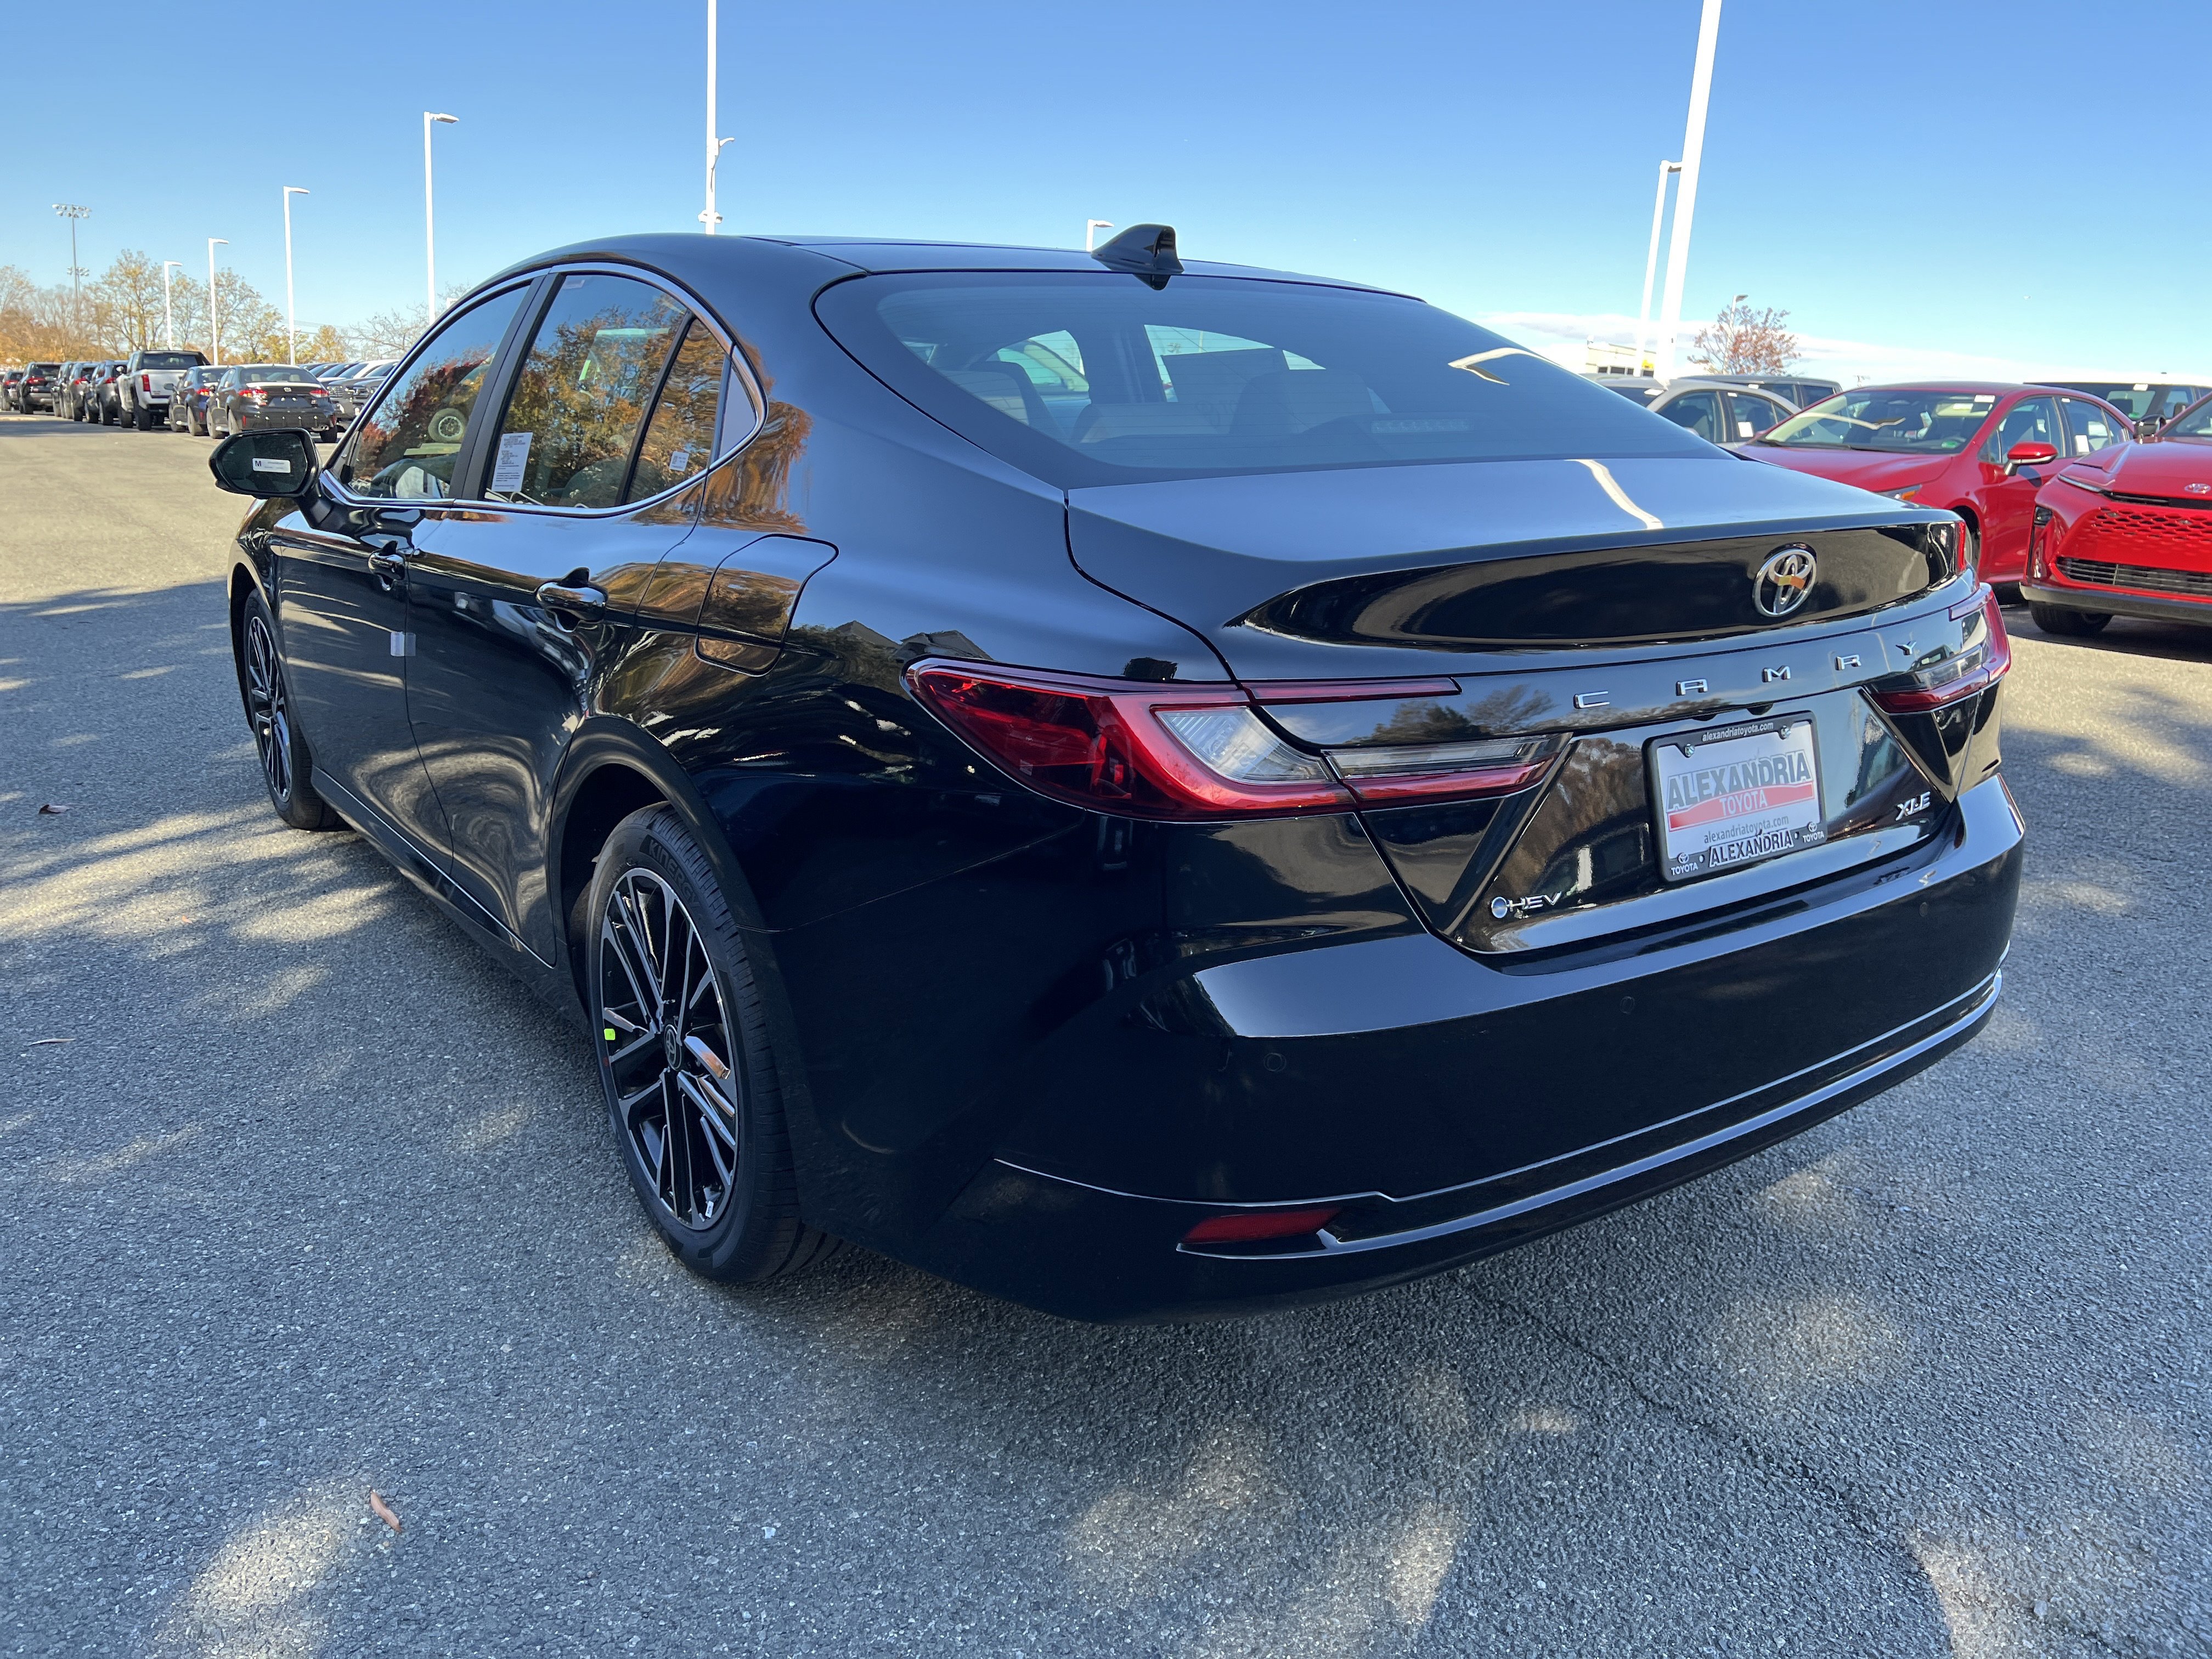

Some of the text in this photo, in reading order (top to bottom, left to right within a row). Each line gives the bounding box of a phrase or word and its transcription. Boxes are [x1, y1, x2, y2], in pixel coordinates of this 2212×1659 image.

[1573, 640, 1917, 709] CAMRY
[1702, 722, 1774, 742] alexandriatoyota.com
[1668, 752, 1812, 810] ALEXANDRIA
[1719, 790, 1768, 816] TOYOTA
[1895, 792, 1931, 821] XLE
[1704, 815, 1789, 844] alexandriatoyota.com
[1803, 831, 1825, 843] TOYOTA
[1708, 830, 1794, 868] ALEXANDRIA
[649, 839, 700, 909] KINERGY
[1671, 862, 1699, 876] TOYOTA
[1508, 891, 1562, 912] HEV
